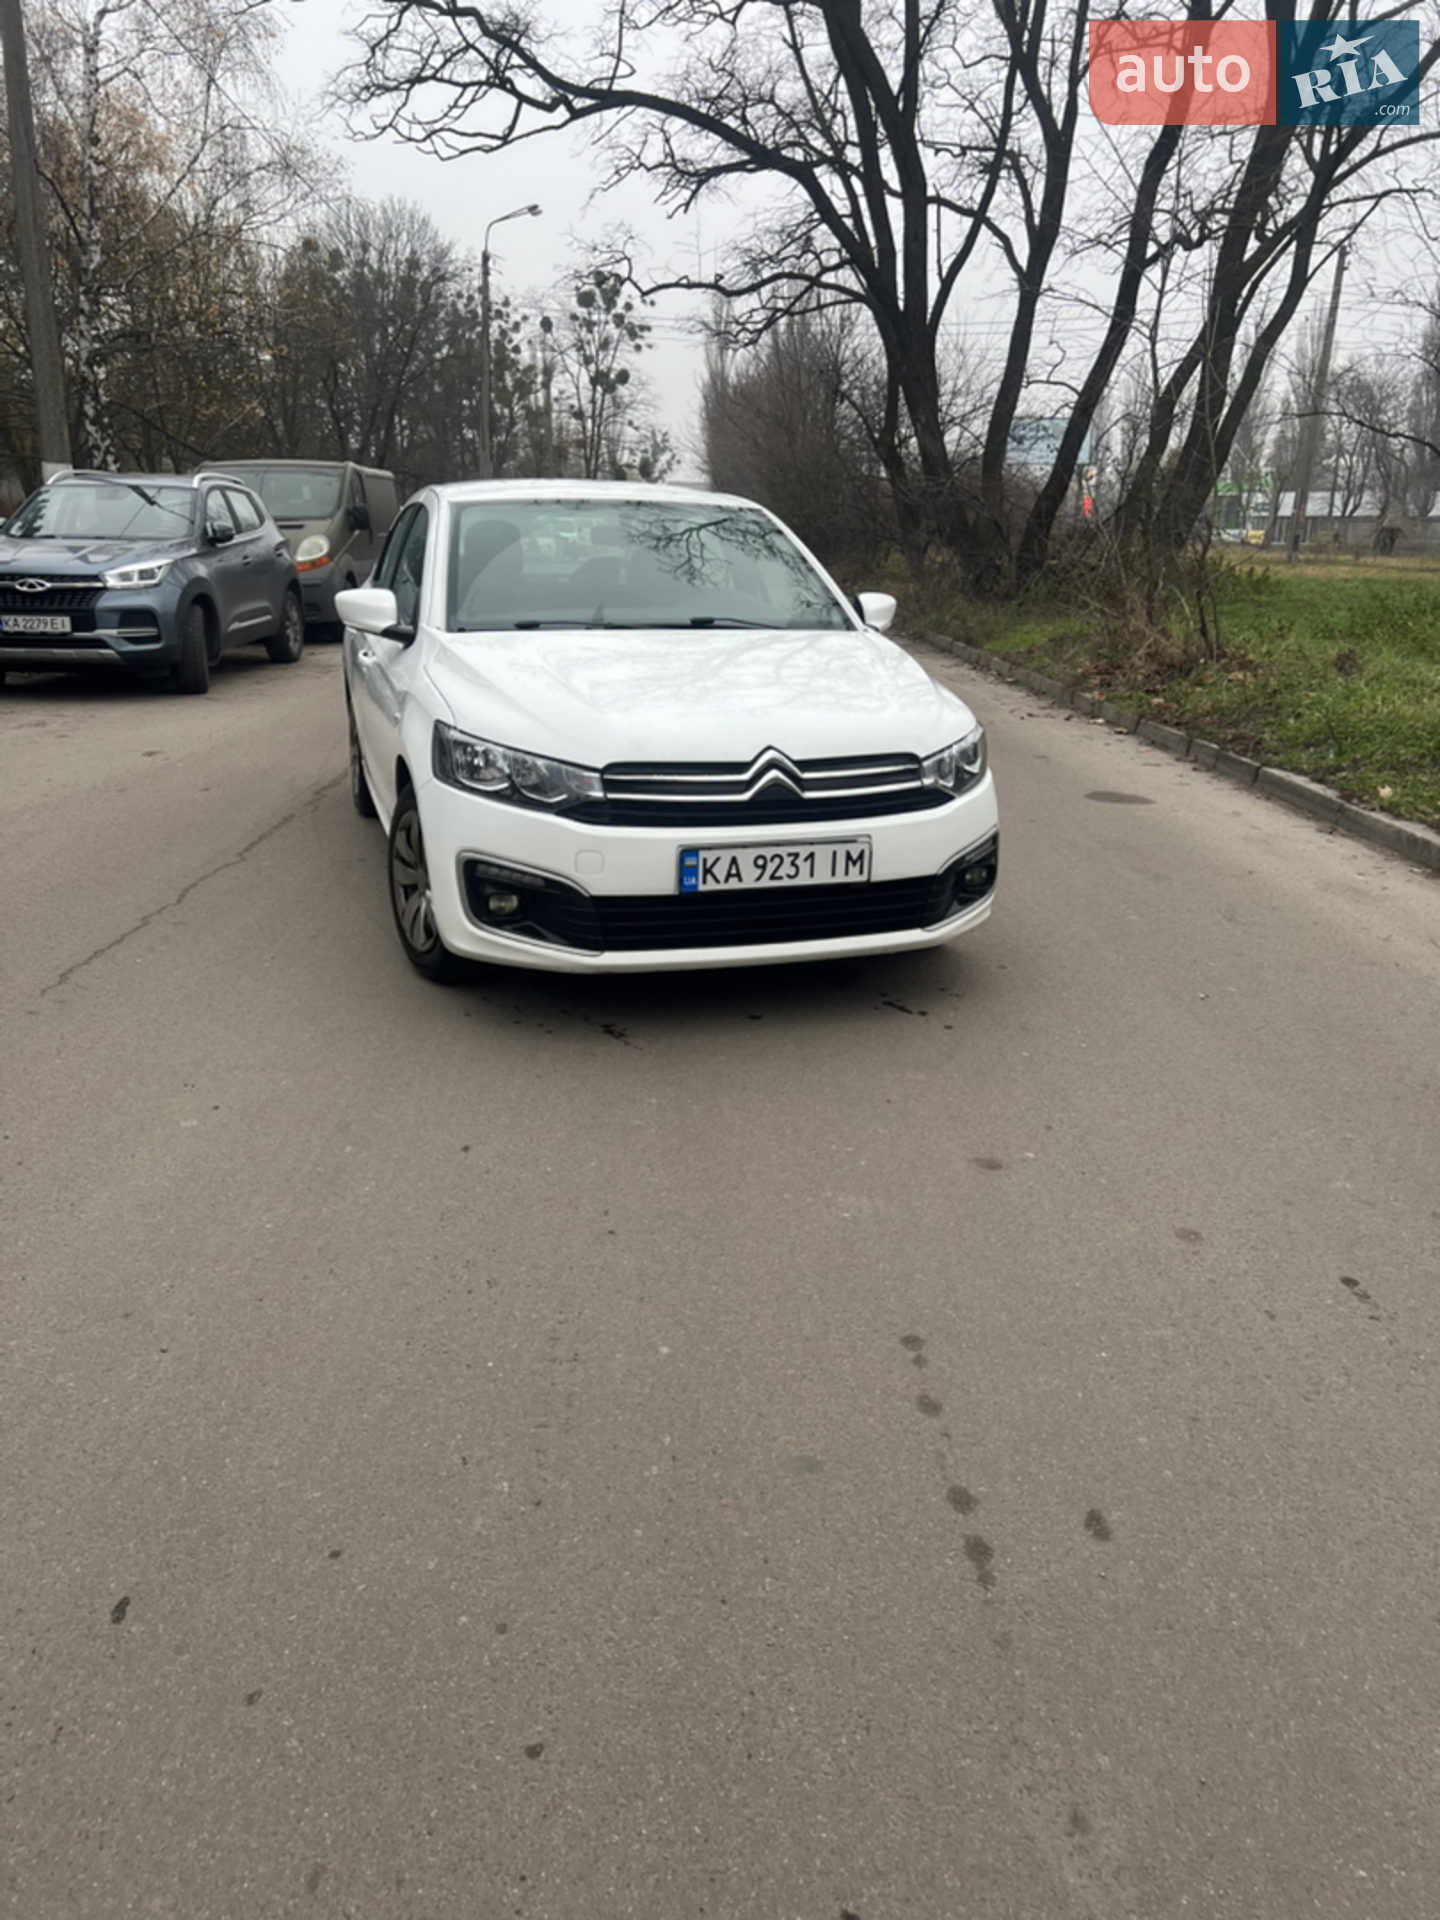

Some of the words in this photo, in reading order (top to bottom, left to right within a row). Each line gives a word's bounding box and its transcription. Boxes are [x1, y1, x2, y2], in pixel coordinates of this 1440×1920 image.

[3, 617, 20, 629] KA
[22, 618, 48, 630] 2279
[702, 855, 743, 885] KA
[753, 851, 816, 883] 9231
[831, 848, 866, 878] IM
[684, 876, 697, 886] UA
